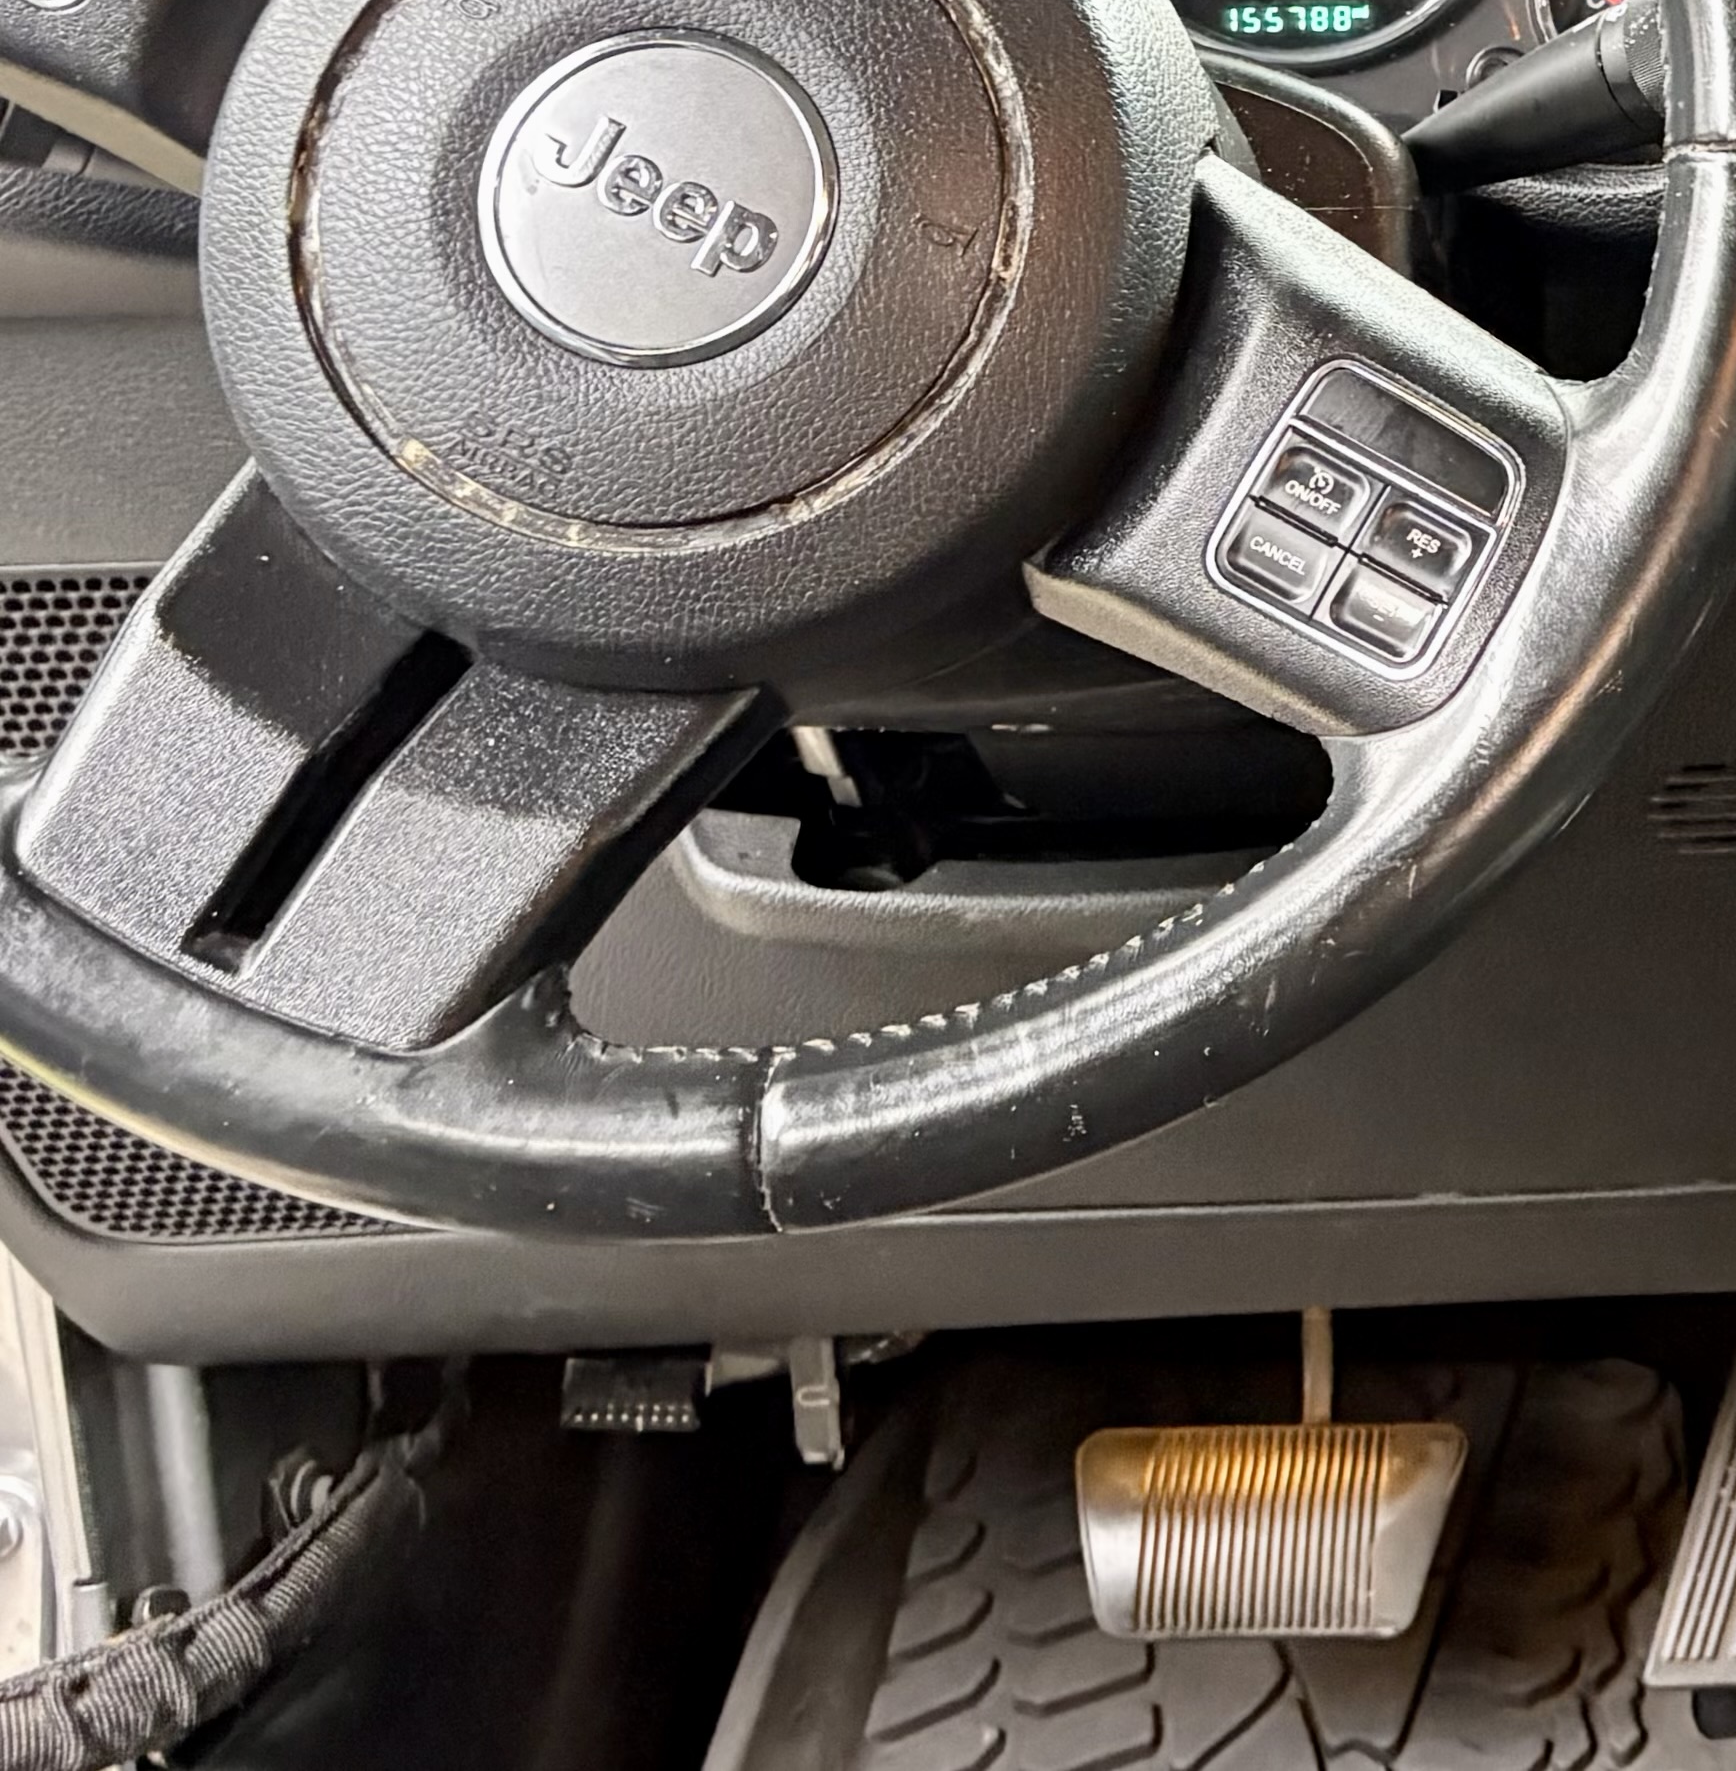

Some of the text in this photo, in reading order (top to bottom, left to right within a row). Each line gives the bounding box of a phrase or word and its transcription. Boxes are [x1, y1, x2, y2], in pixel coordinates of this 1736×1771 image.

[1229, 5, 1352, 33] 155788
[531, 113, 780, 278] Jeep
[1285, 482, 1341, 516] ON/OFF
[1250, 534, 1306, 576] CANCEL
[1406, 528, 1442, 555] RES
